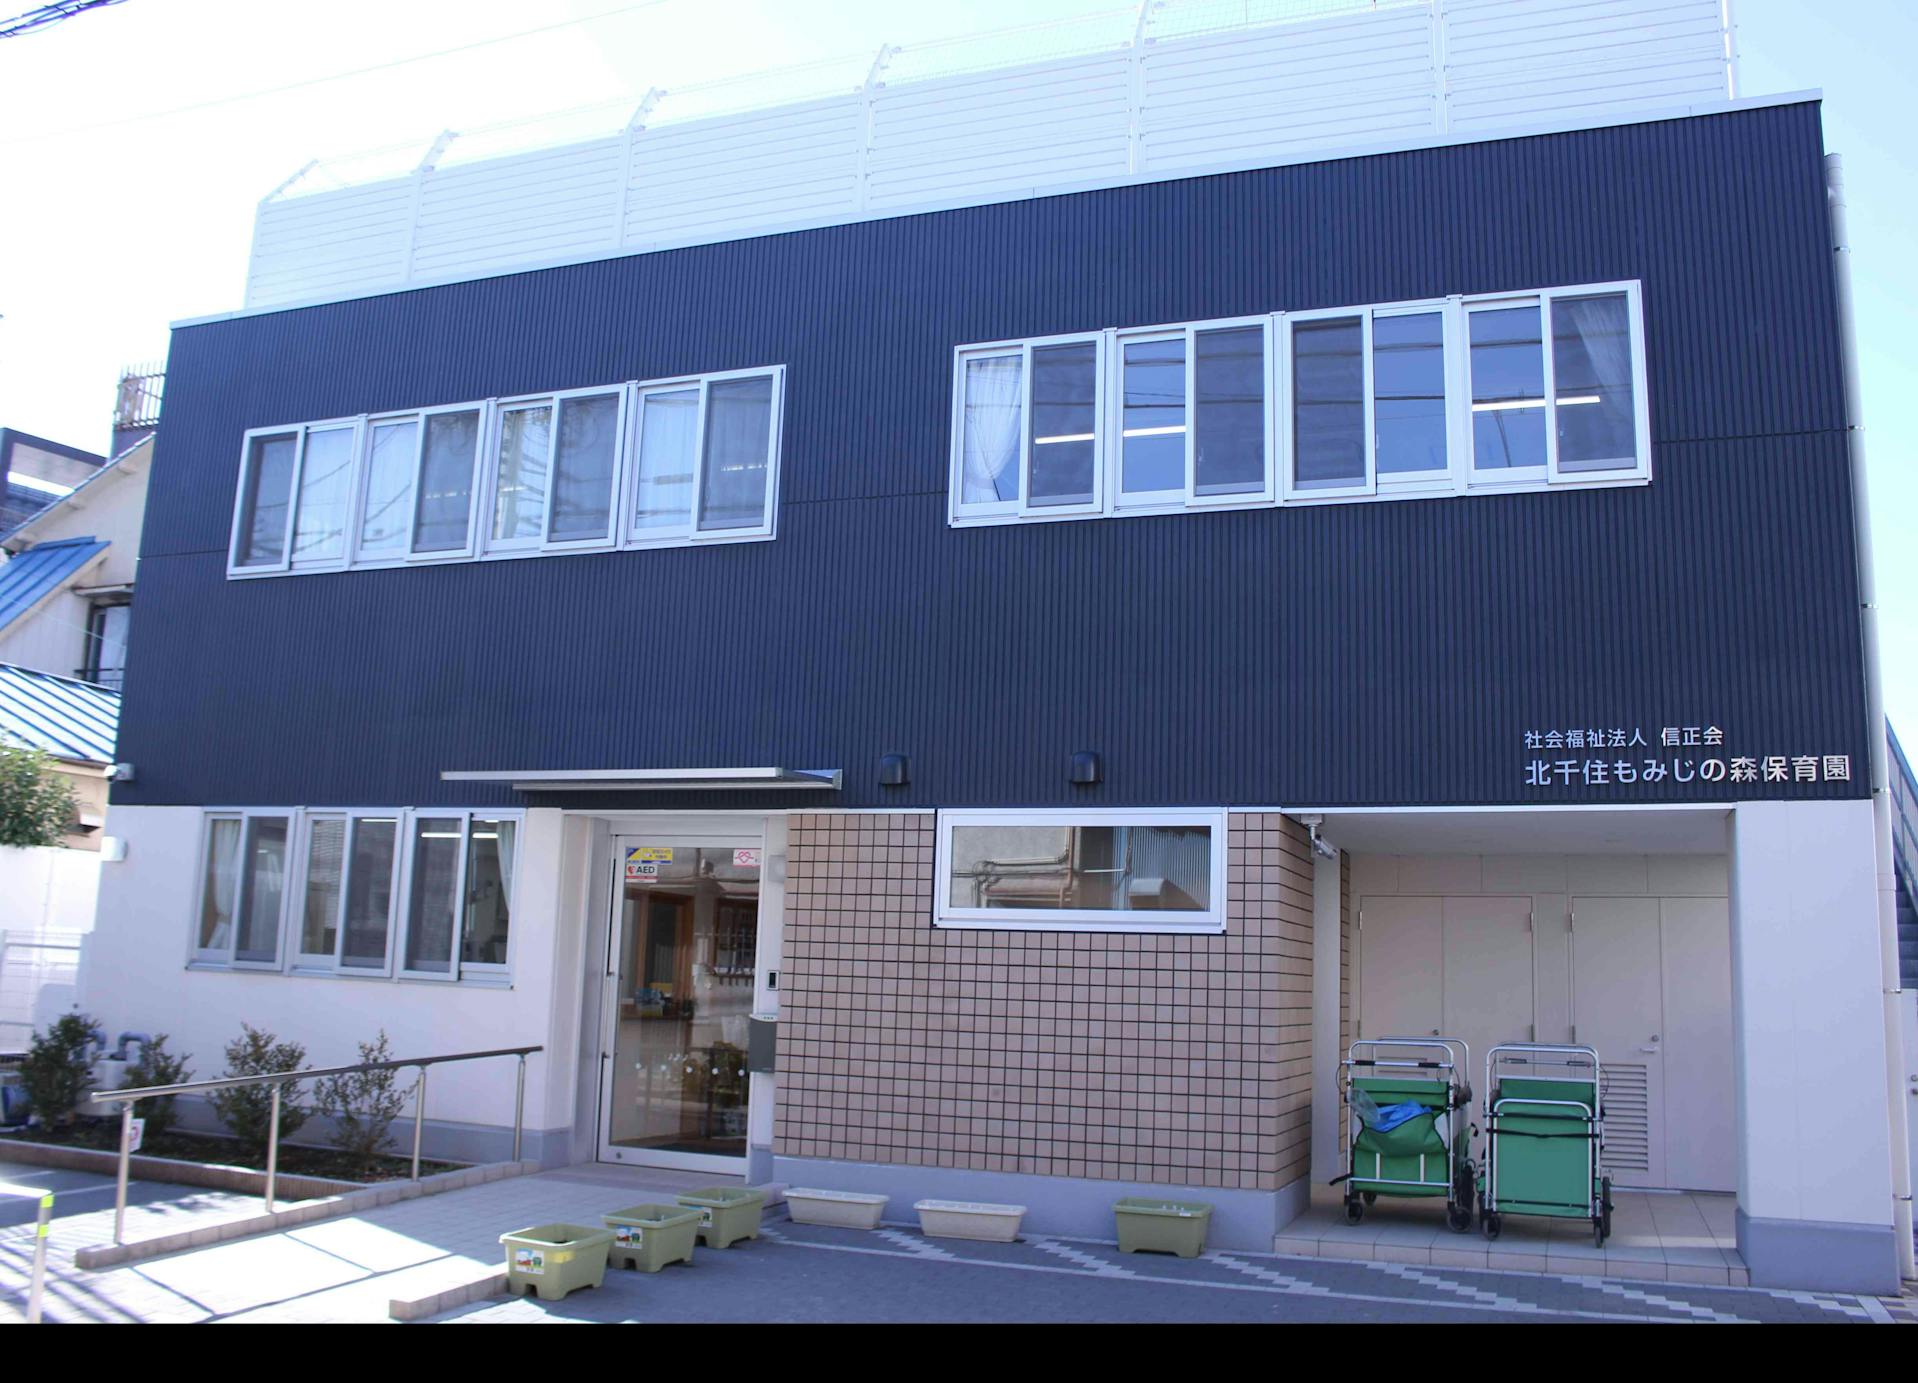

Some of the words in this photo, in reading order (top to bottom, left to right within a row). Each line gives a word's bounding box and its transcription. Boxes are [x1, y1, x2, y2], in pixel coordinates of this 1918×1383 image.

[1524, 727, 1648, 749] 社会福祉法人
[1660, 726, 1724, 747] 信正会
[1524, 754, 1851, 786] 北千住もみじの森保育園
[636, 865, 655, 874] AED
